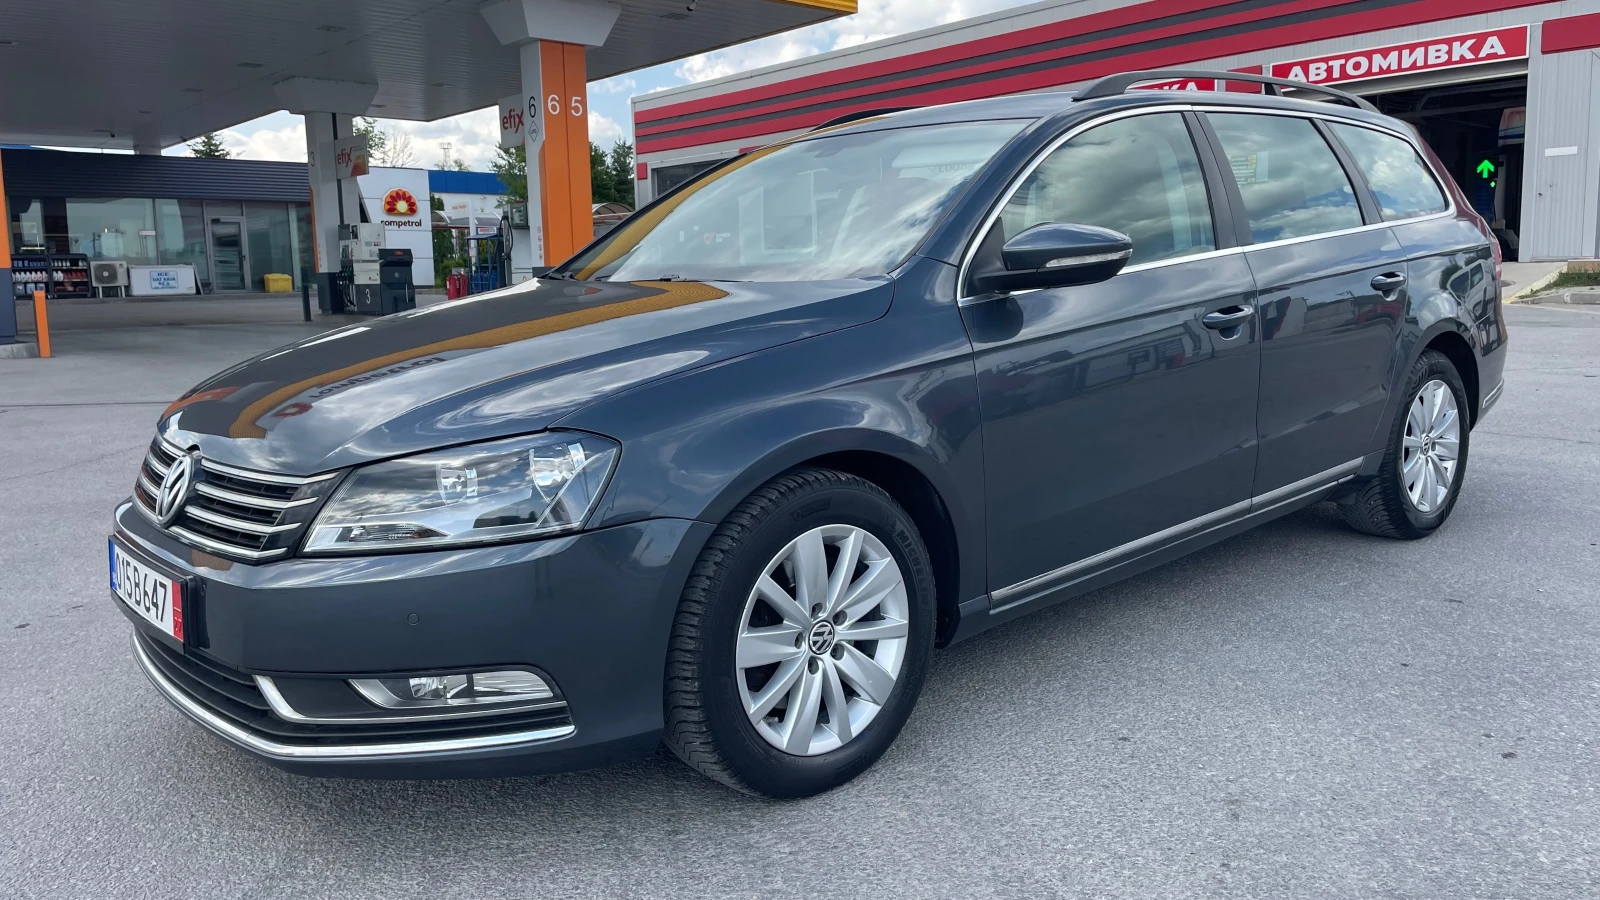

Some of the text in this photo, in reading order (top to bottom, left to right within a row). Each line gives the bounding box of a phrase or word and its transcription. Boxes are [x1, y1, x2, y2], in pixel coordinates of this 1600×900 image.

[1287, 35, 1506, 83] АВТОМИВКА
[528, 96, 537, 118] 6
[548, 94, 560, 115] 6
[571, 96, 583, 117] 5
[502, 108, 525, 134] efix
[310, 151, 315, 168] 3
[337, 147, 353, 168] efix
[381, 218, 422, 229] rompetrol
[365, 288, 371, 304] 3
[115, 552, 168, 622] 015B647
